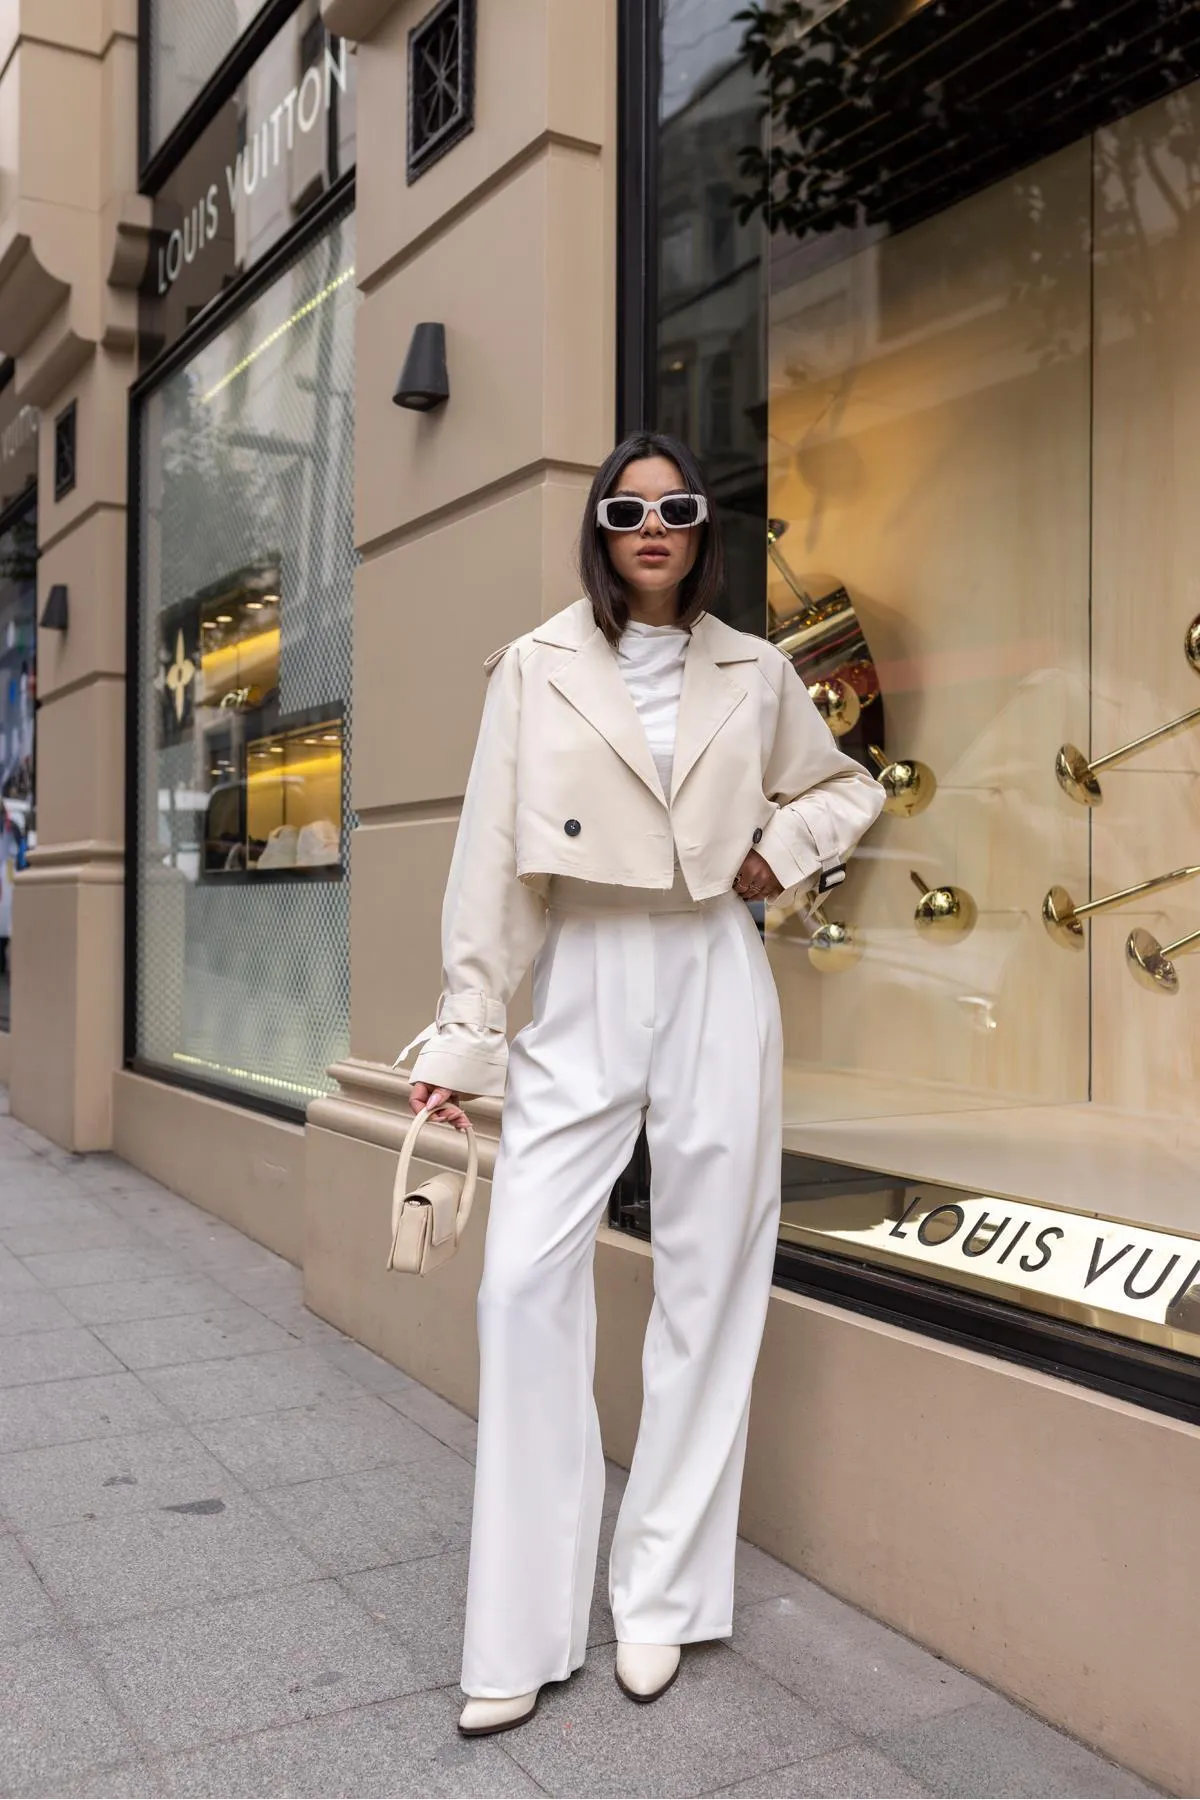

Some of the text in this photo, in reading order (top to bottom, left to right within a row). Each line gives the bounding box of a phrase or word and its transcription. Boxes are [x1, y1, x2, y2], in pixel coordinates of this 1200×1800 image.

[157, 36, 347, 294] LOUIS VUITTON
[888, 1196, 1065, 1273] LOUIS
